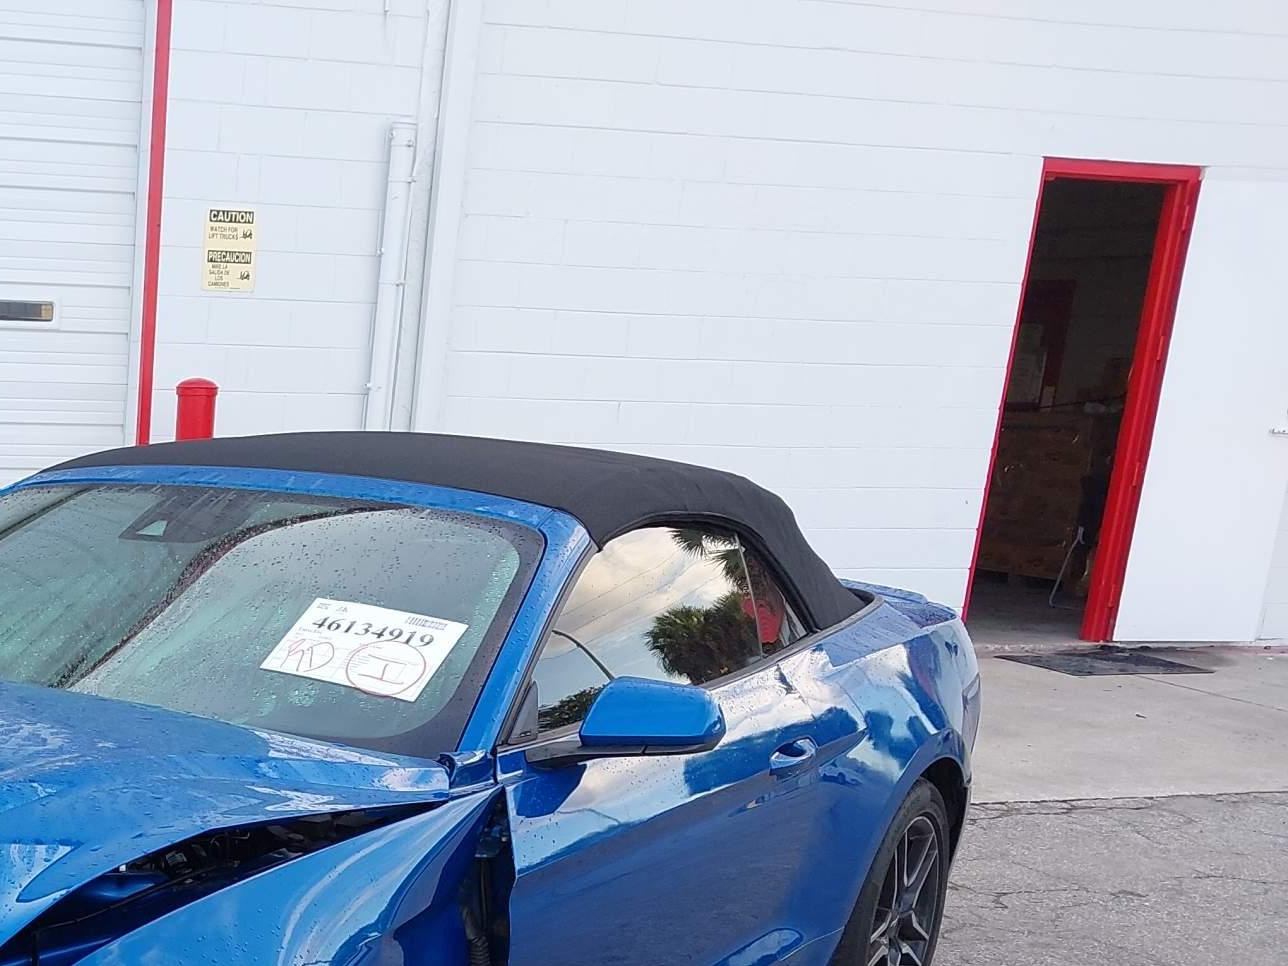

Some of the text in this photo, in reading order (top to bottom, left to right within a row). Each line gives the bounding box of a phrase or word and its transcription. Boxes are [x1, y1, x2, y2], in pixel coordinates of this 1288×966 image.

[211, 210, 253, 223] CAUTION
[208, 251, 251, 263] PRECAUCION
[312, 616, 434, 647] 46134919
